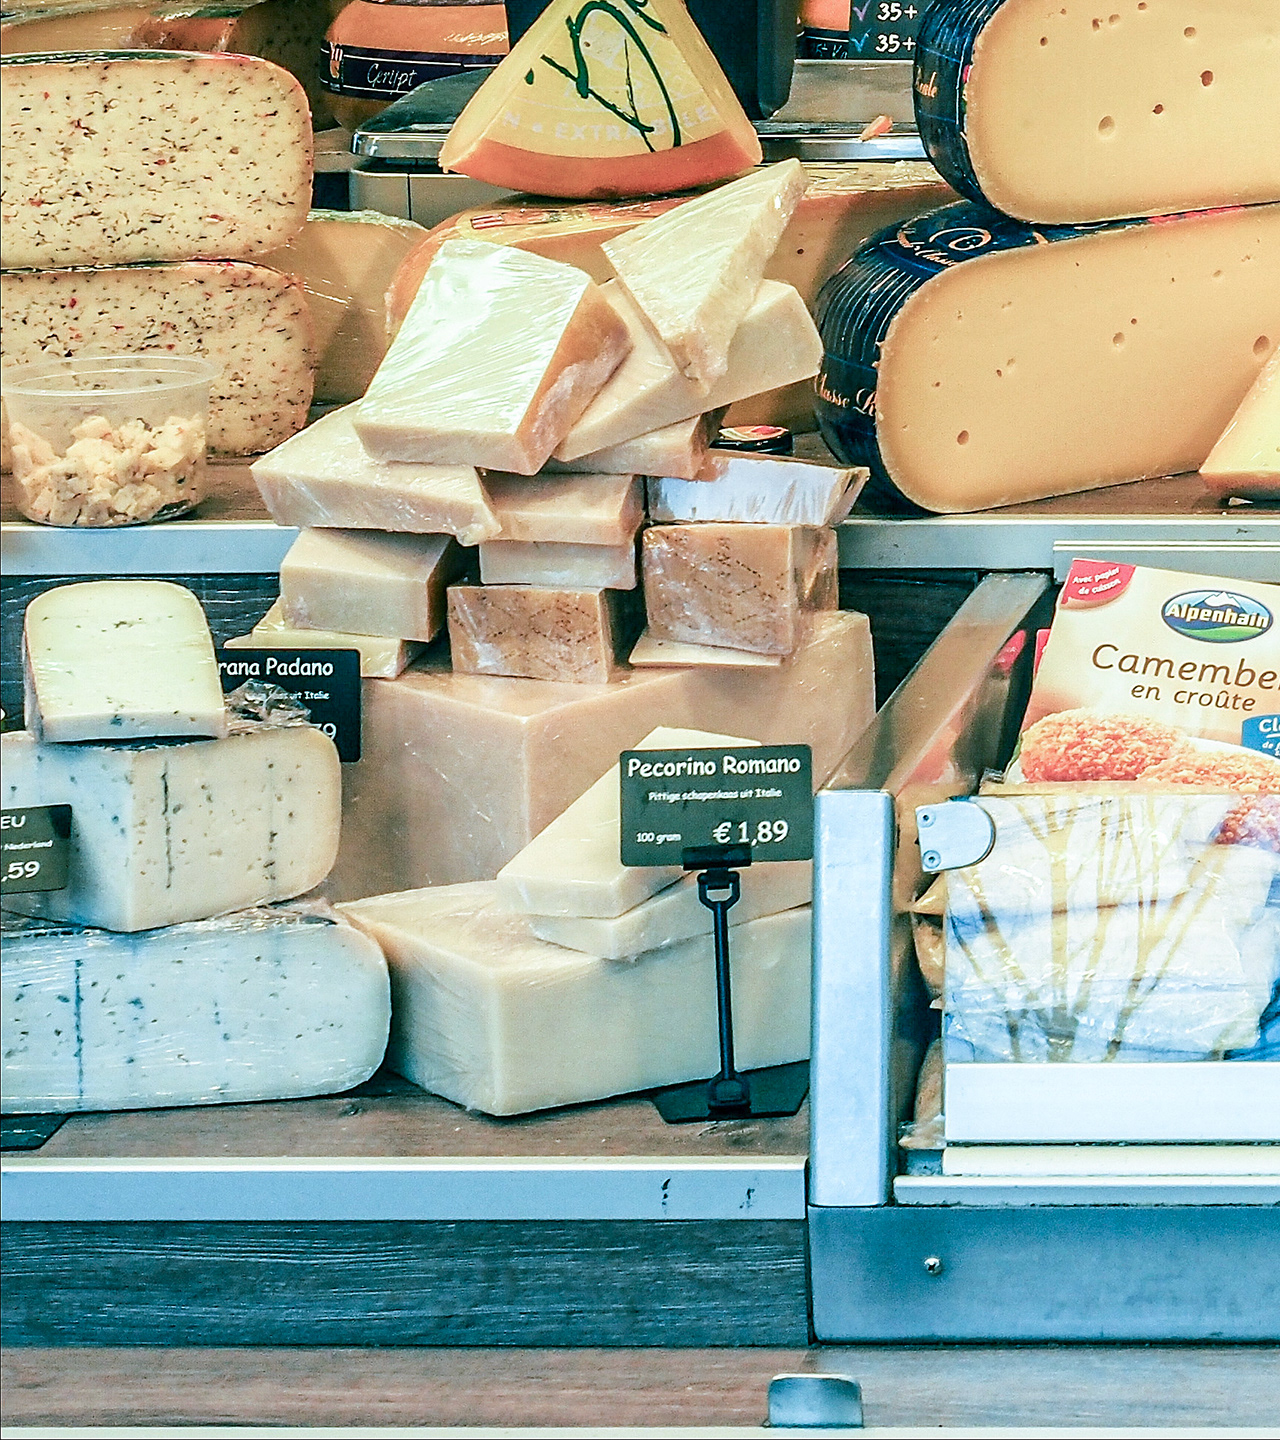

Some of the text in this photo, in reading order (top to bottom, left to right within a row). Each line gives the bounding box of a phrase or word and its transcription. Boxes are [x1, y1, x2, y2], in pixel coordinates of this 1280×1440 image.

[876, 2, 918, 22] 35+
[875, 34, 916, 53] 35+
[1071, 566, 1121, 585] Avec papier
[1078, 578, 1122, 596] de cuisson
[1164, 601, 1270, 630] Alpenhain
[266, 656, 334, 676] Padano
[1131, 682, 1257, 712] en croûte
[627, 755, 801, 778] Pecorino Romano
[681, 789, 739, 803] schapenkaas
[740, 788, 754, 799] uit
[754, 788, 783, 799] Italie
[636, 819, 789, 846] 100 gram € 1,89
